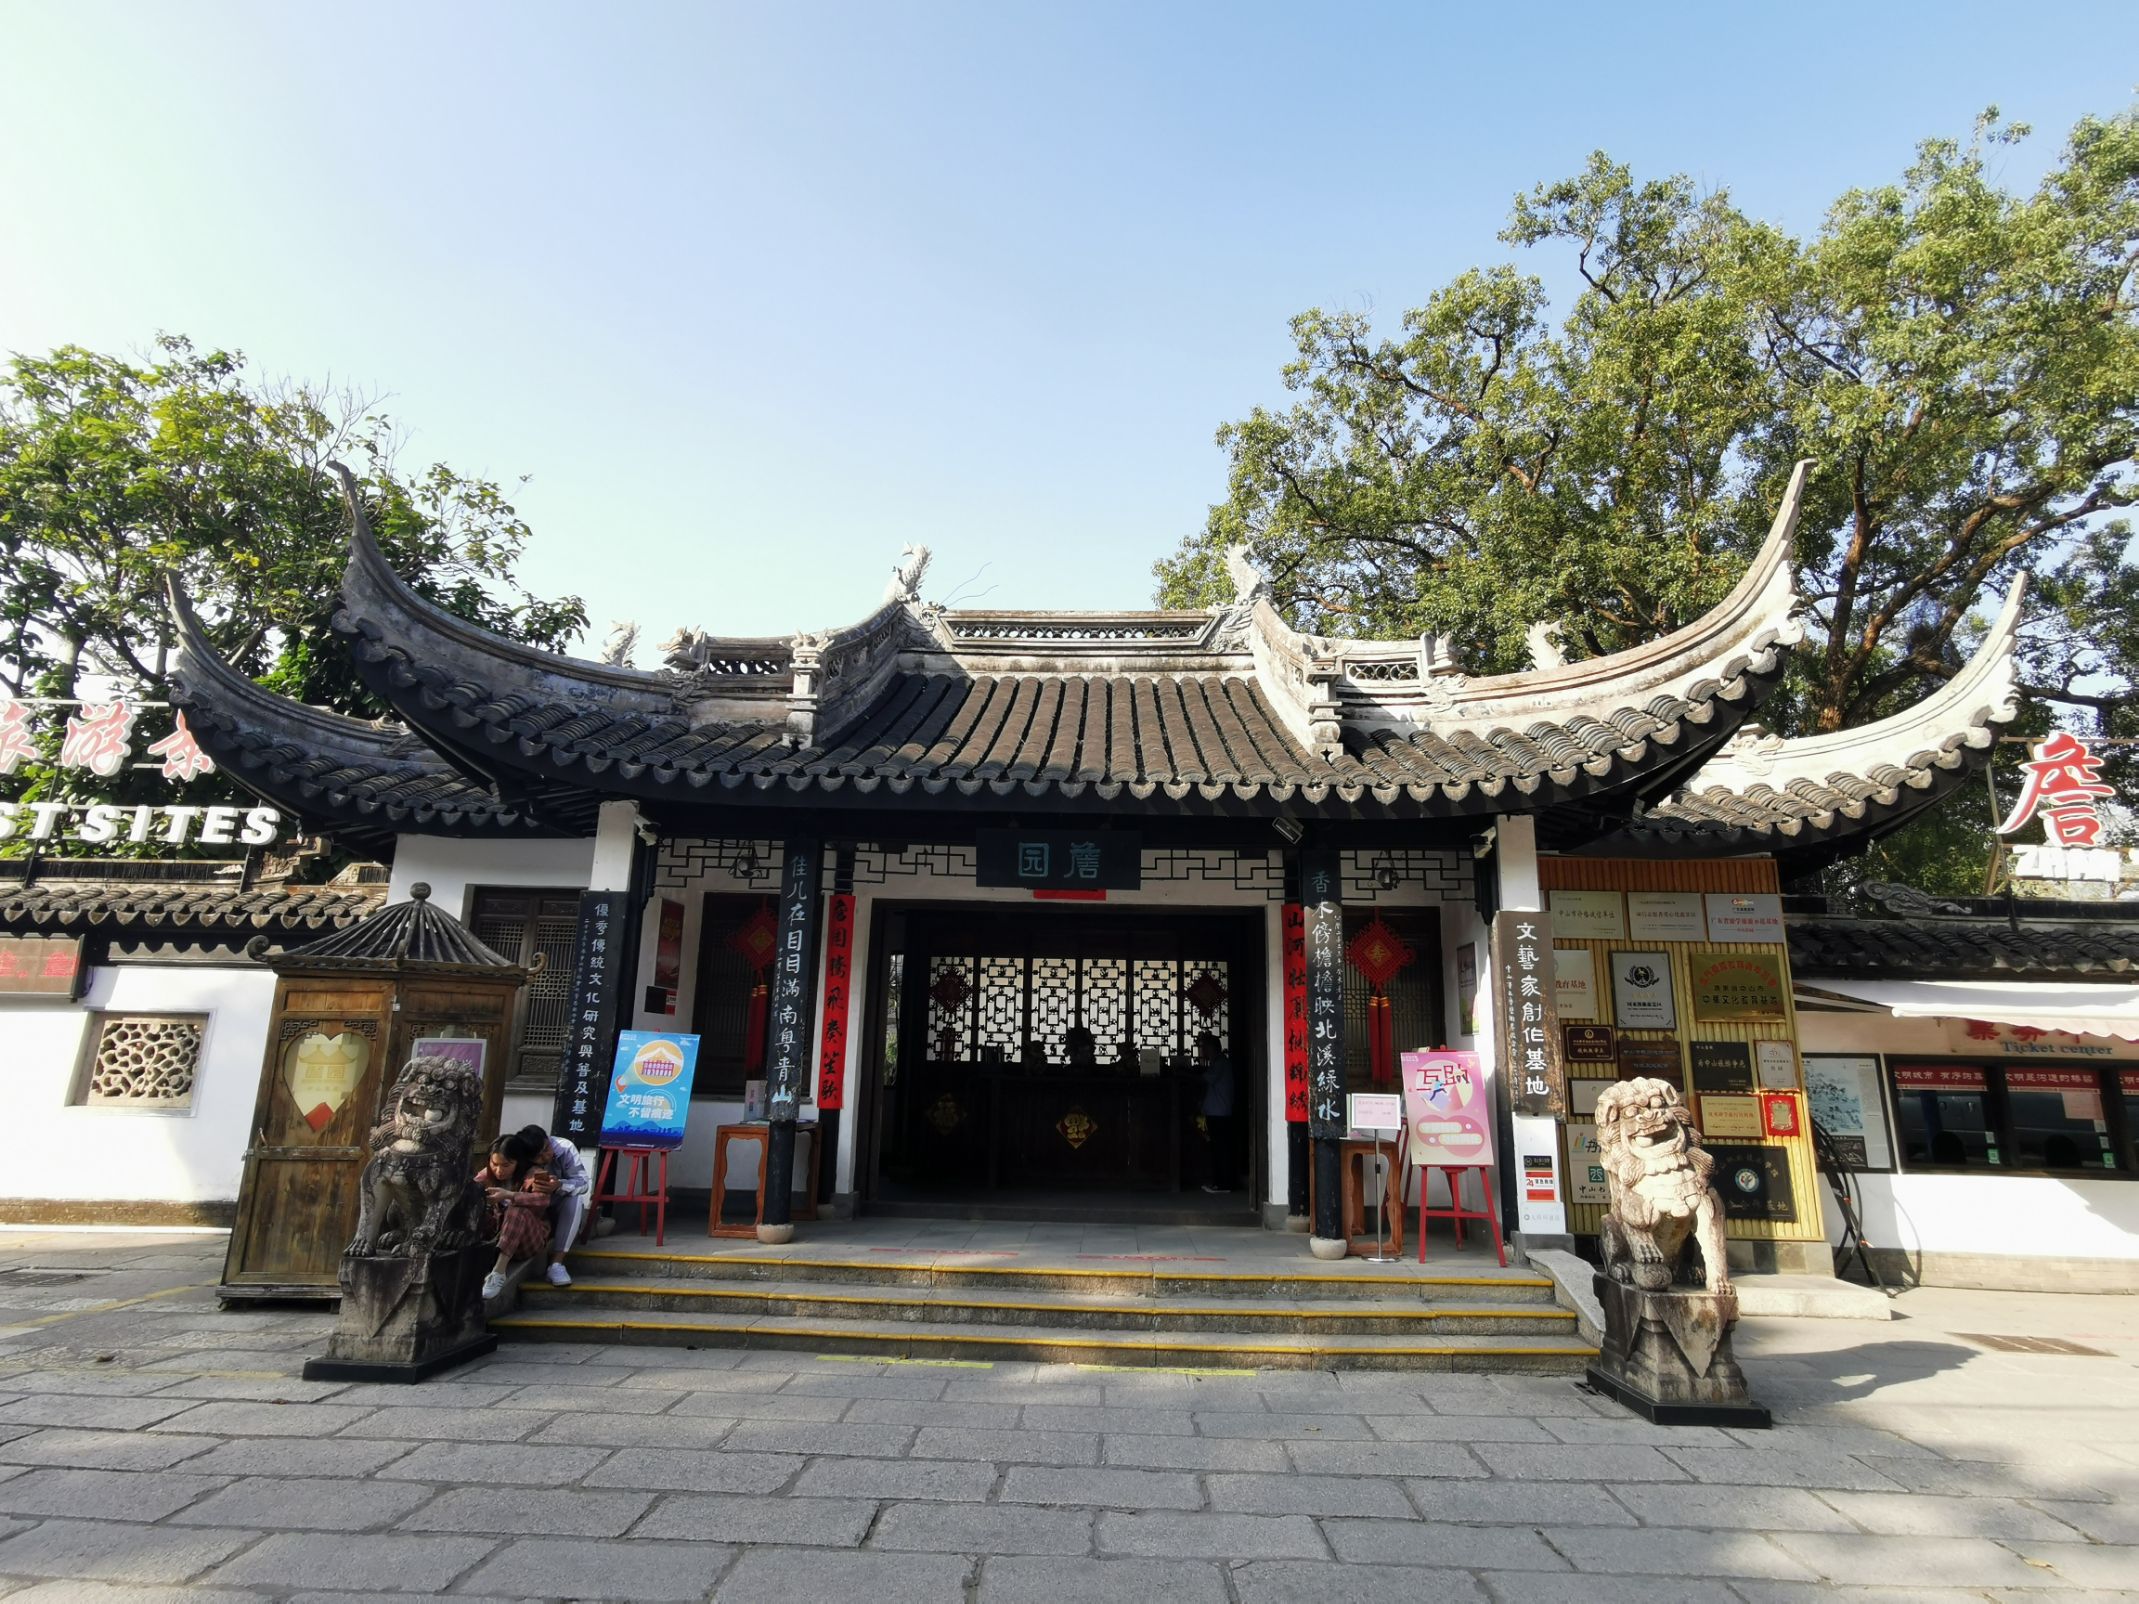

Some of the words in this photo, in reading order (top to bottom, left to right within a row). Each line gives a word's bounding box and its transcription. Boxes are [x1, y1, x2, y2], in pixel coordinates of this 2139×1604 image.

[1996, 732, 2117, 847] 詹
[80, 804, 281, 846] SITES
[2001, 1040, 2055, 1054] Ticket
[2060, 1044, 2113, 1055] center
